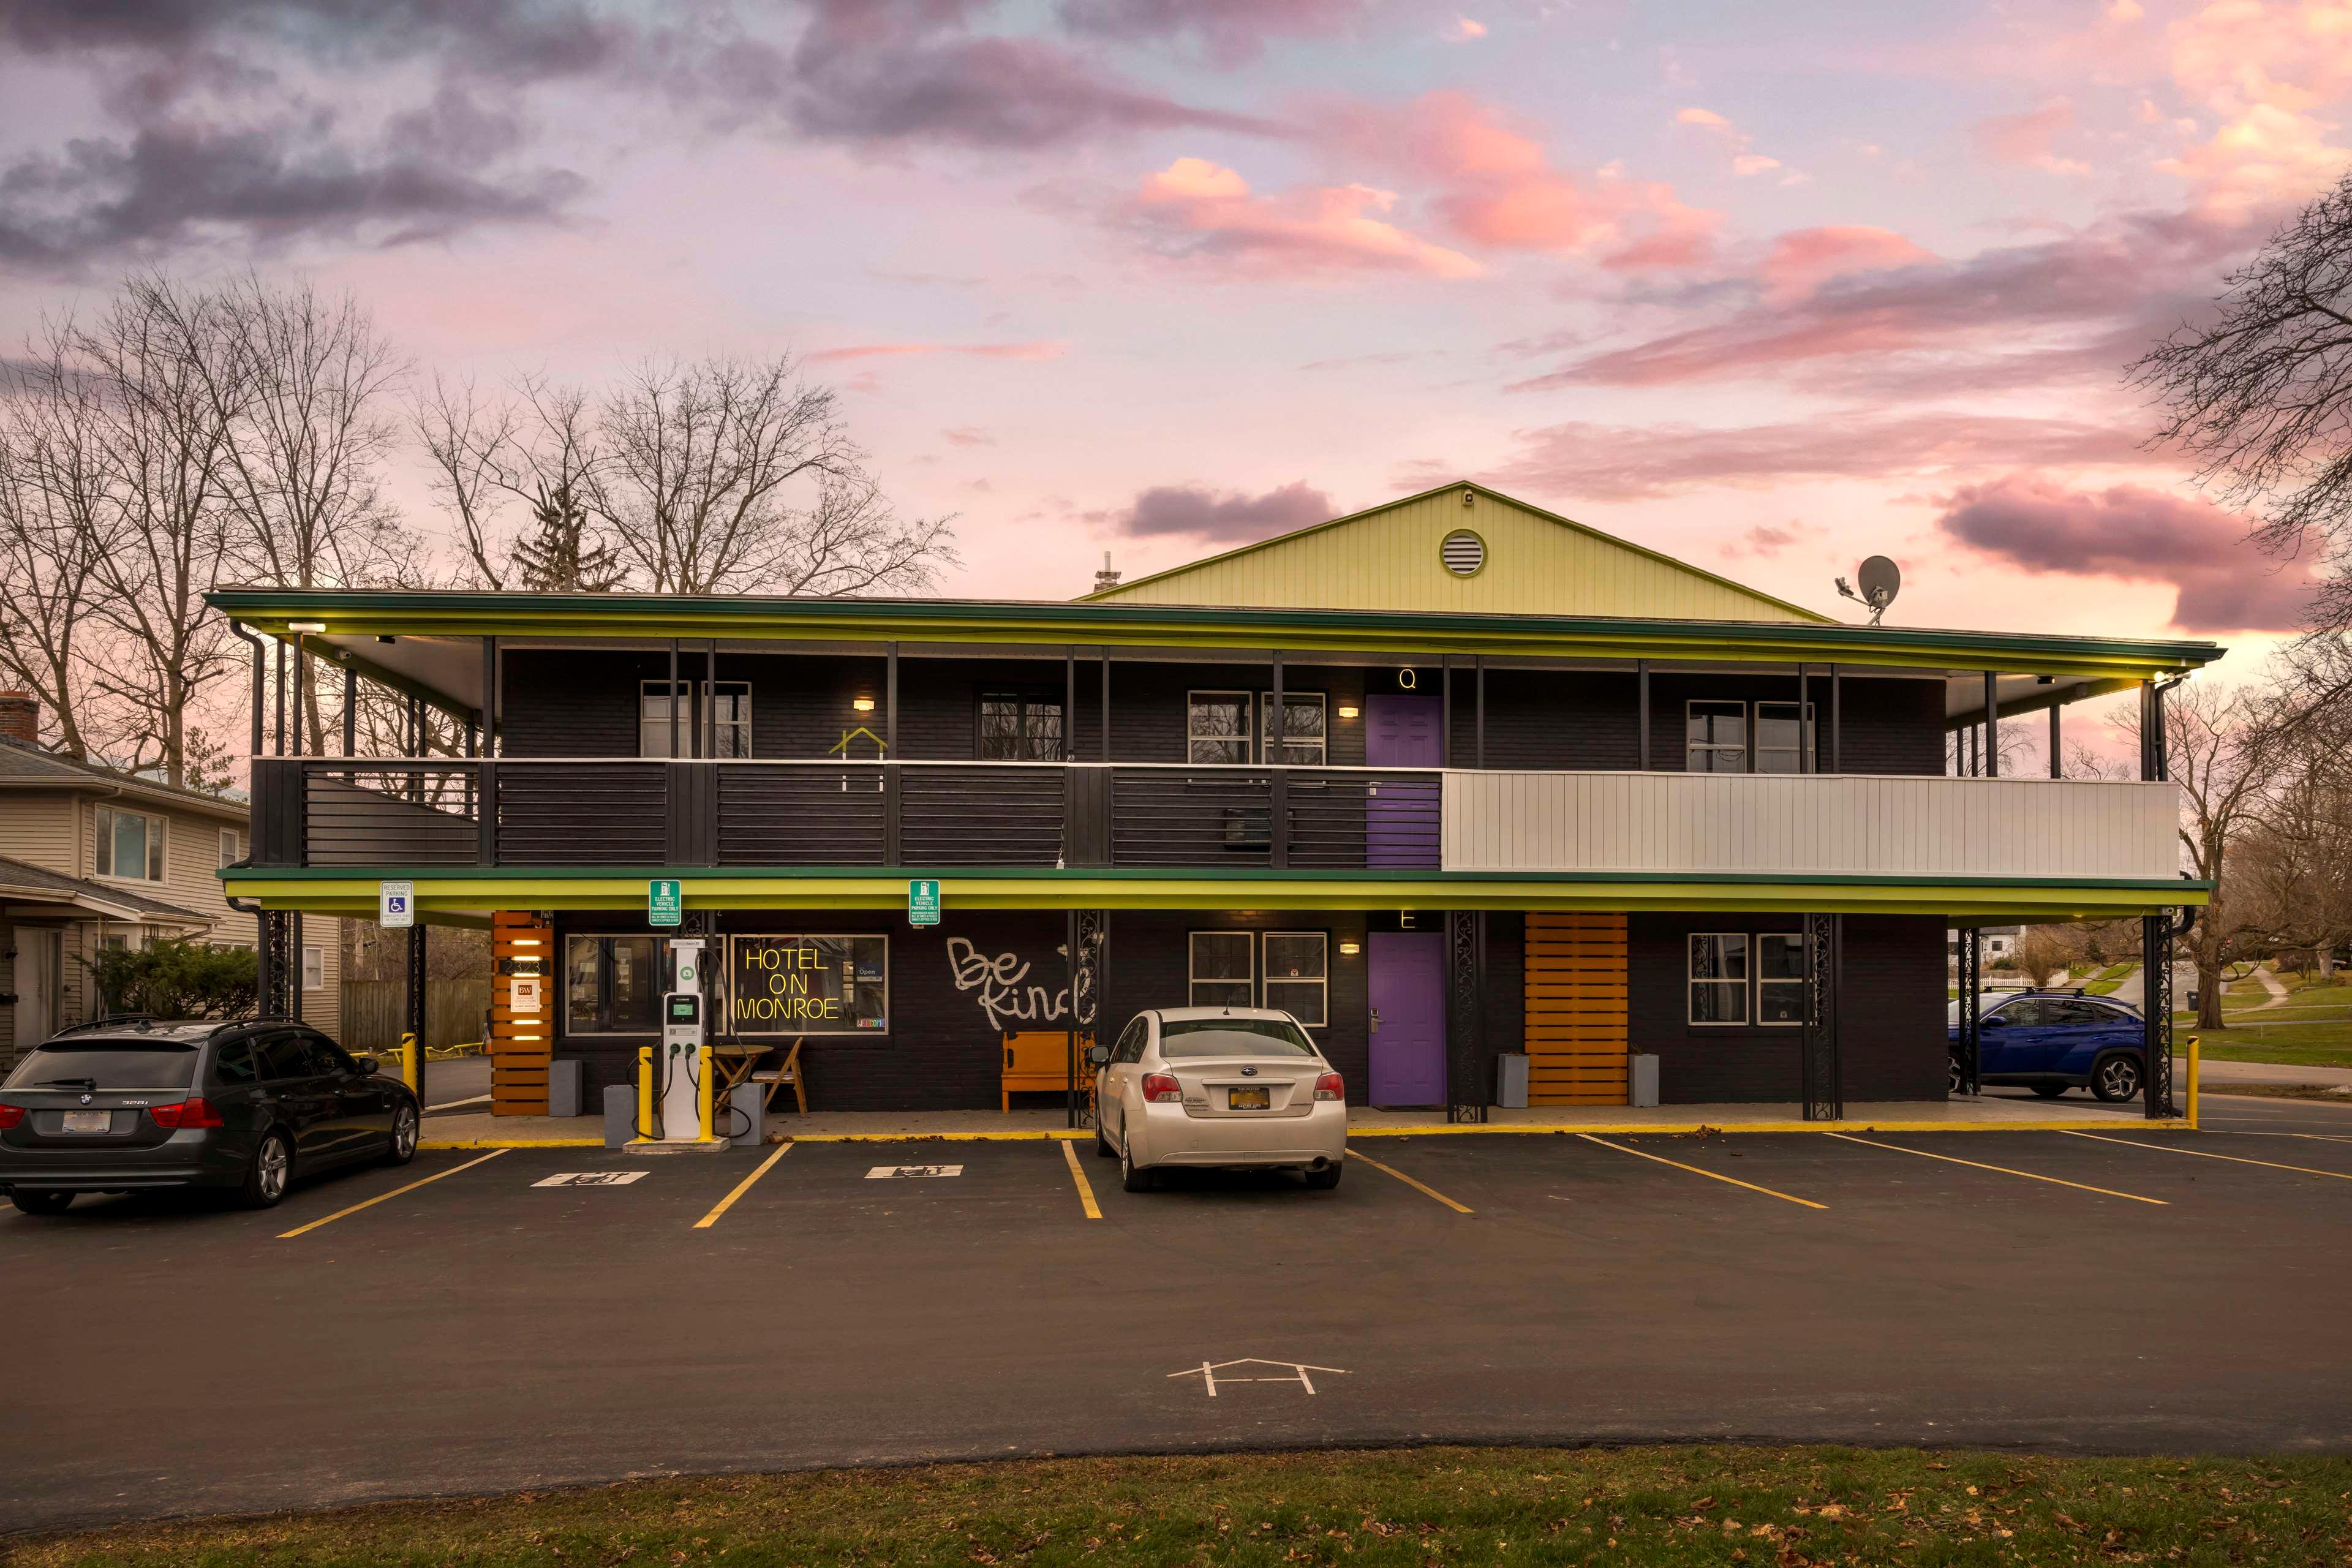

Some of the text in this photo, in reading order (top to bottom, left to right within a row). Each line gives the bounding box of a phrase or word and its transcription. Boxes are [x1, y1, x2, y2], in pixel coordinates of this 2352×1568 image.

[1399, 668, 1416, 688] Q
[1401, 909, 1415, 928] E
[505, 960, 540, 973] 2323
[746, 948, 829, 970] HOTEL
[946, 937, 1031, 990] Be
[769, 973, 807, 995] ON
[737, 998, 839, 1019] MONROE
[857, 1019, 885, 1028] WELCOME
